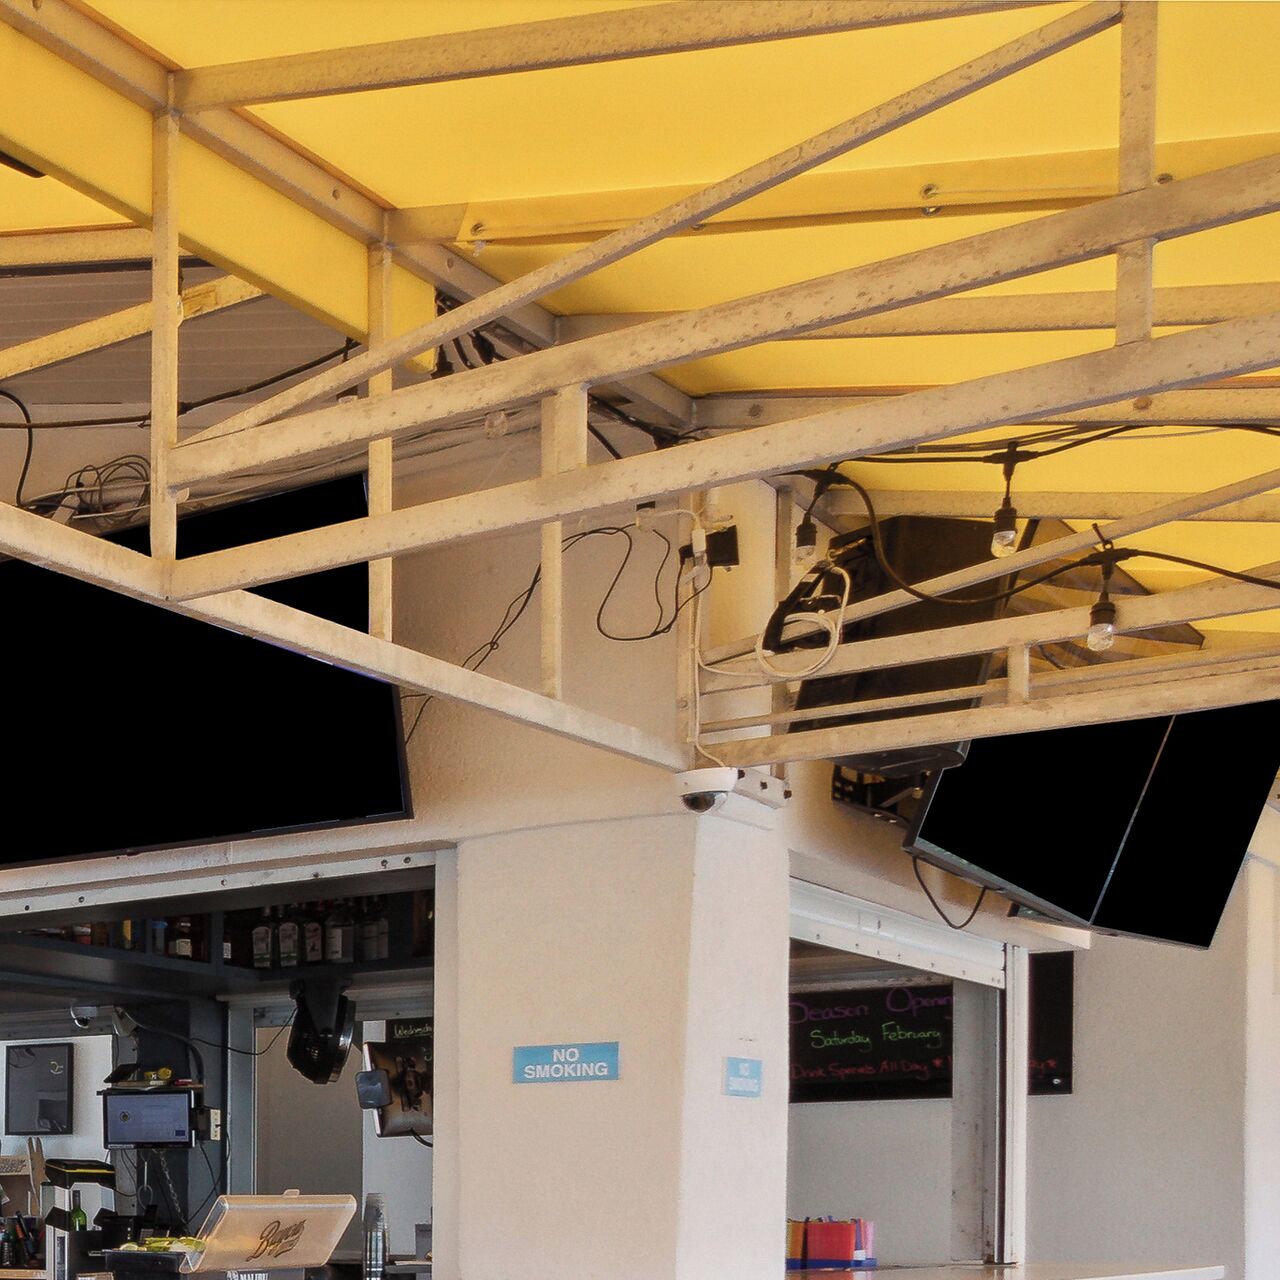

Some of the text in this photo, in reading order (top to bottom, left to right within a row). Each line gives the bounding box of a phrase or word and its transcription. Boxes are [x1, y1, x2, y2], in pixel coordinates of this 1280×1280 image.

[886, 987, 953, 1019] Openin
[810, 1021, 942, 1053] Saturday February
[552, 1048, 580, 1062] NO
[523, 1062, 609, 1079] SMOKING
